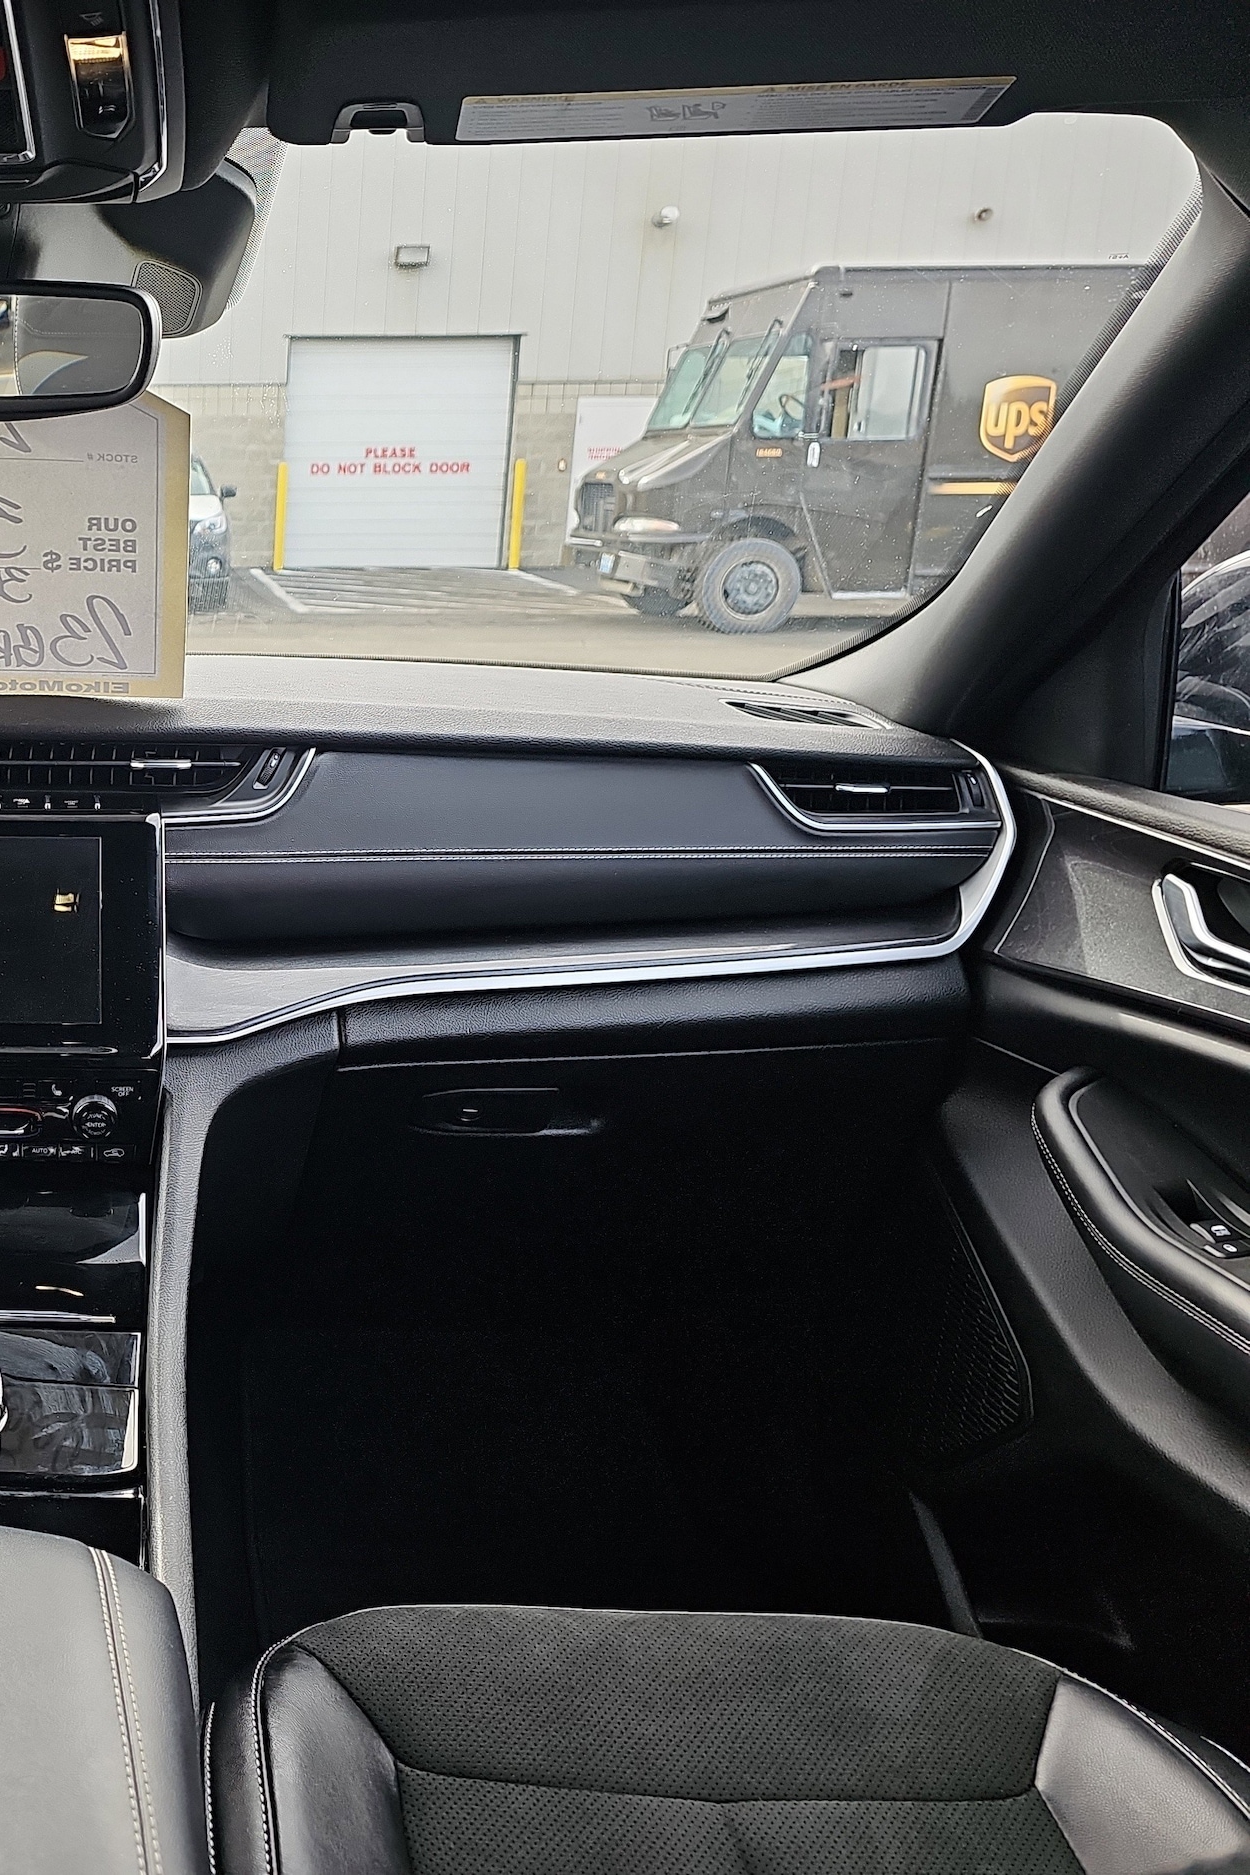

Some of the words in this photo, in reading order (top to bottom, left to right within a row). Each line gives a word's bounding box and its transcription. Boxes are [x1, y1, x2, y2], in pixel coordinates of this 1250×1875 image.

[986, 401, 1049, 449] ups
[365, 447, 416, 458] PLEASE
[310, 463, 330, 474] DO
[337, 463, 366, 474] NOT
[373, 462, 421, 474] BLOCK
[429, 462, 470, 473] DOOR
